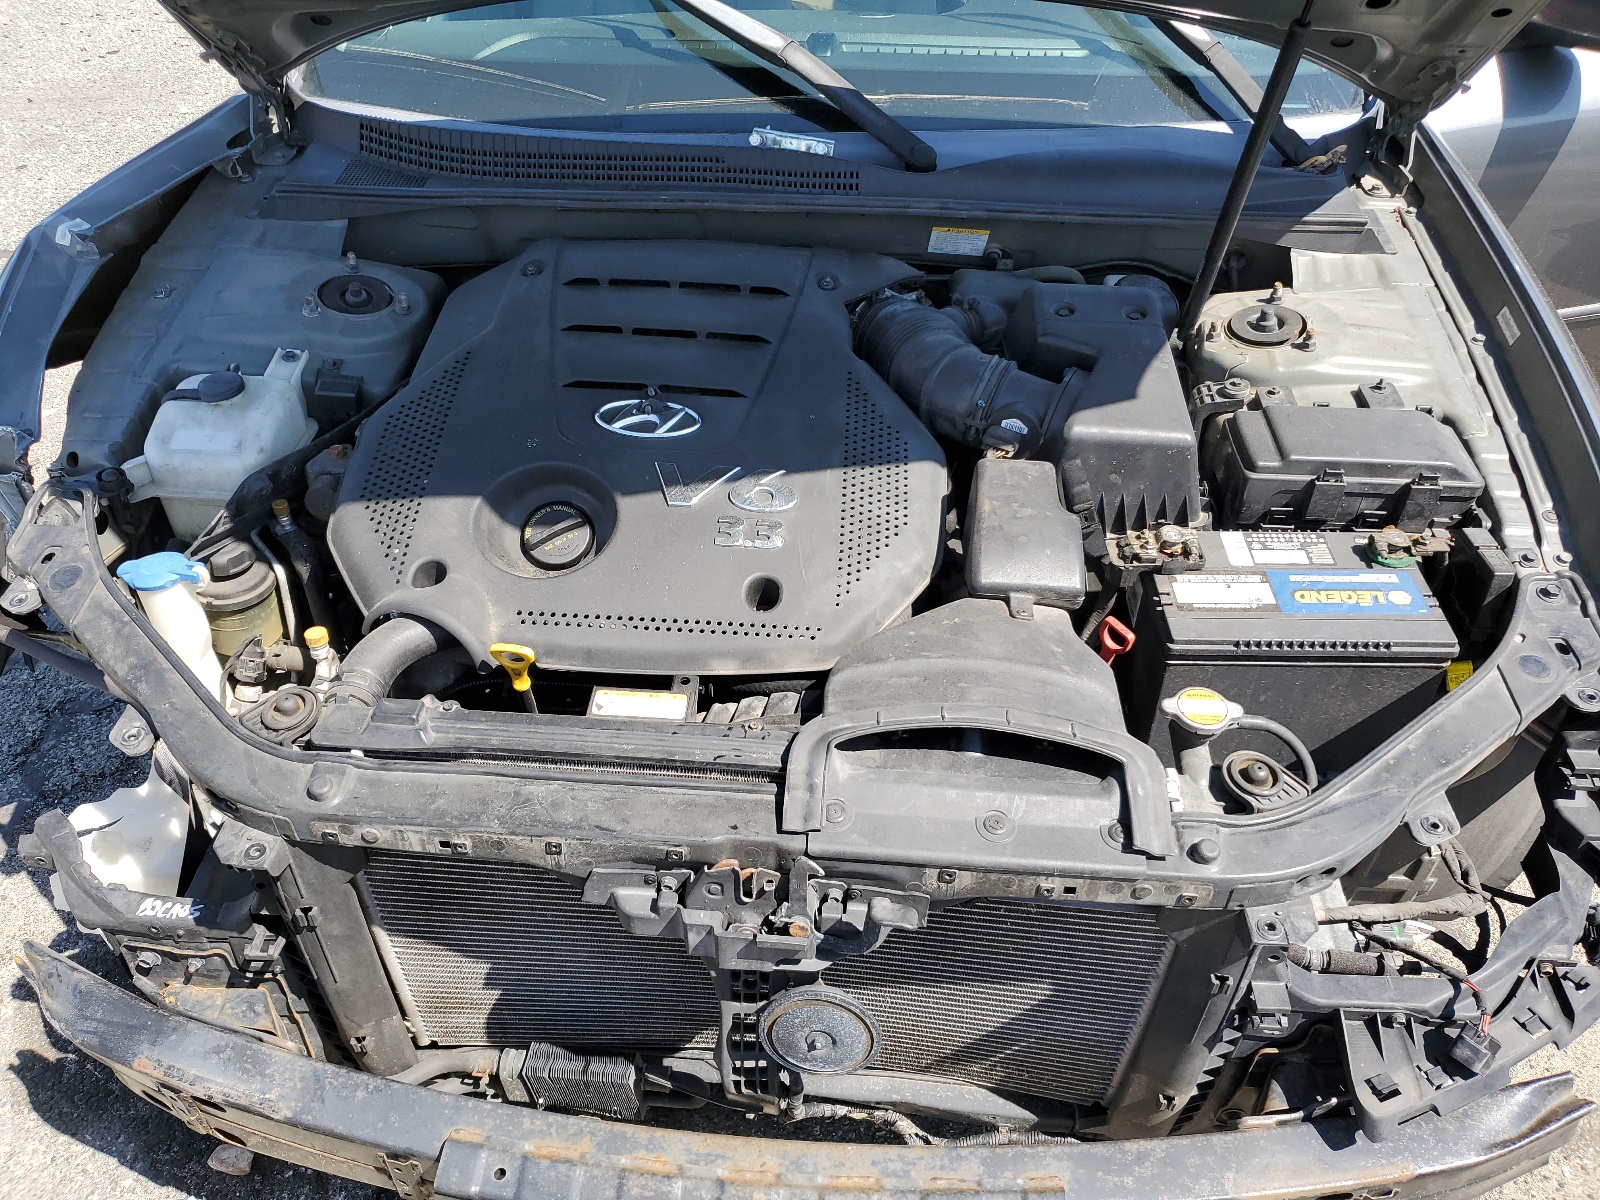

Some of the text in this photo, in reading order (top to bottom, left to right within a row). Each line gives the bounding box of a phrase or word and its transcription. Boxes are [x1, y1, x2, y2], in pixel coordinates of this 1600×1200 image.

[654, 461, 798, 513] V6
[528, 507, 551, 526] OWNER'S
[552, 505, 577, 516] MANUAL
[714, 514, 785, 549] 3.3
[1292, 590, 1386, 605] LEGEND
